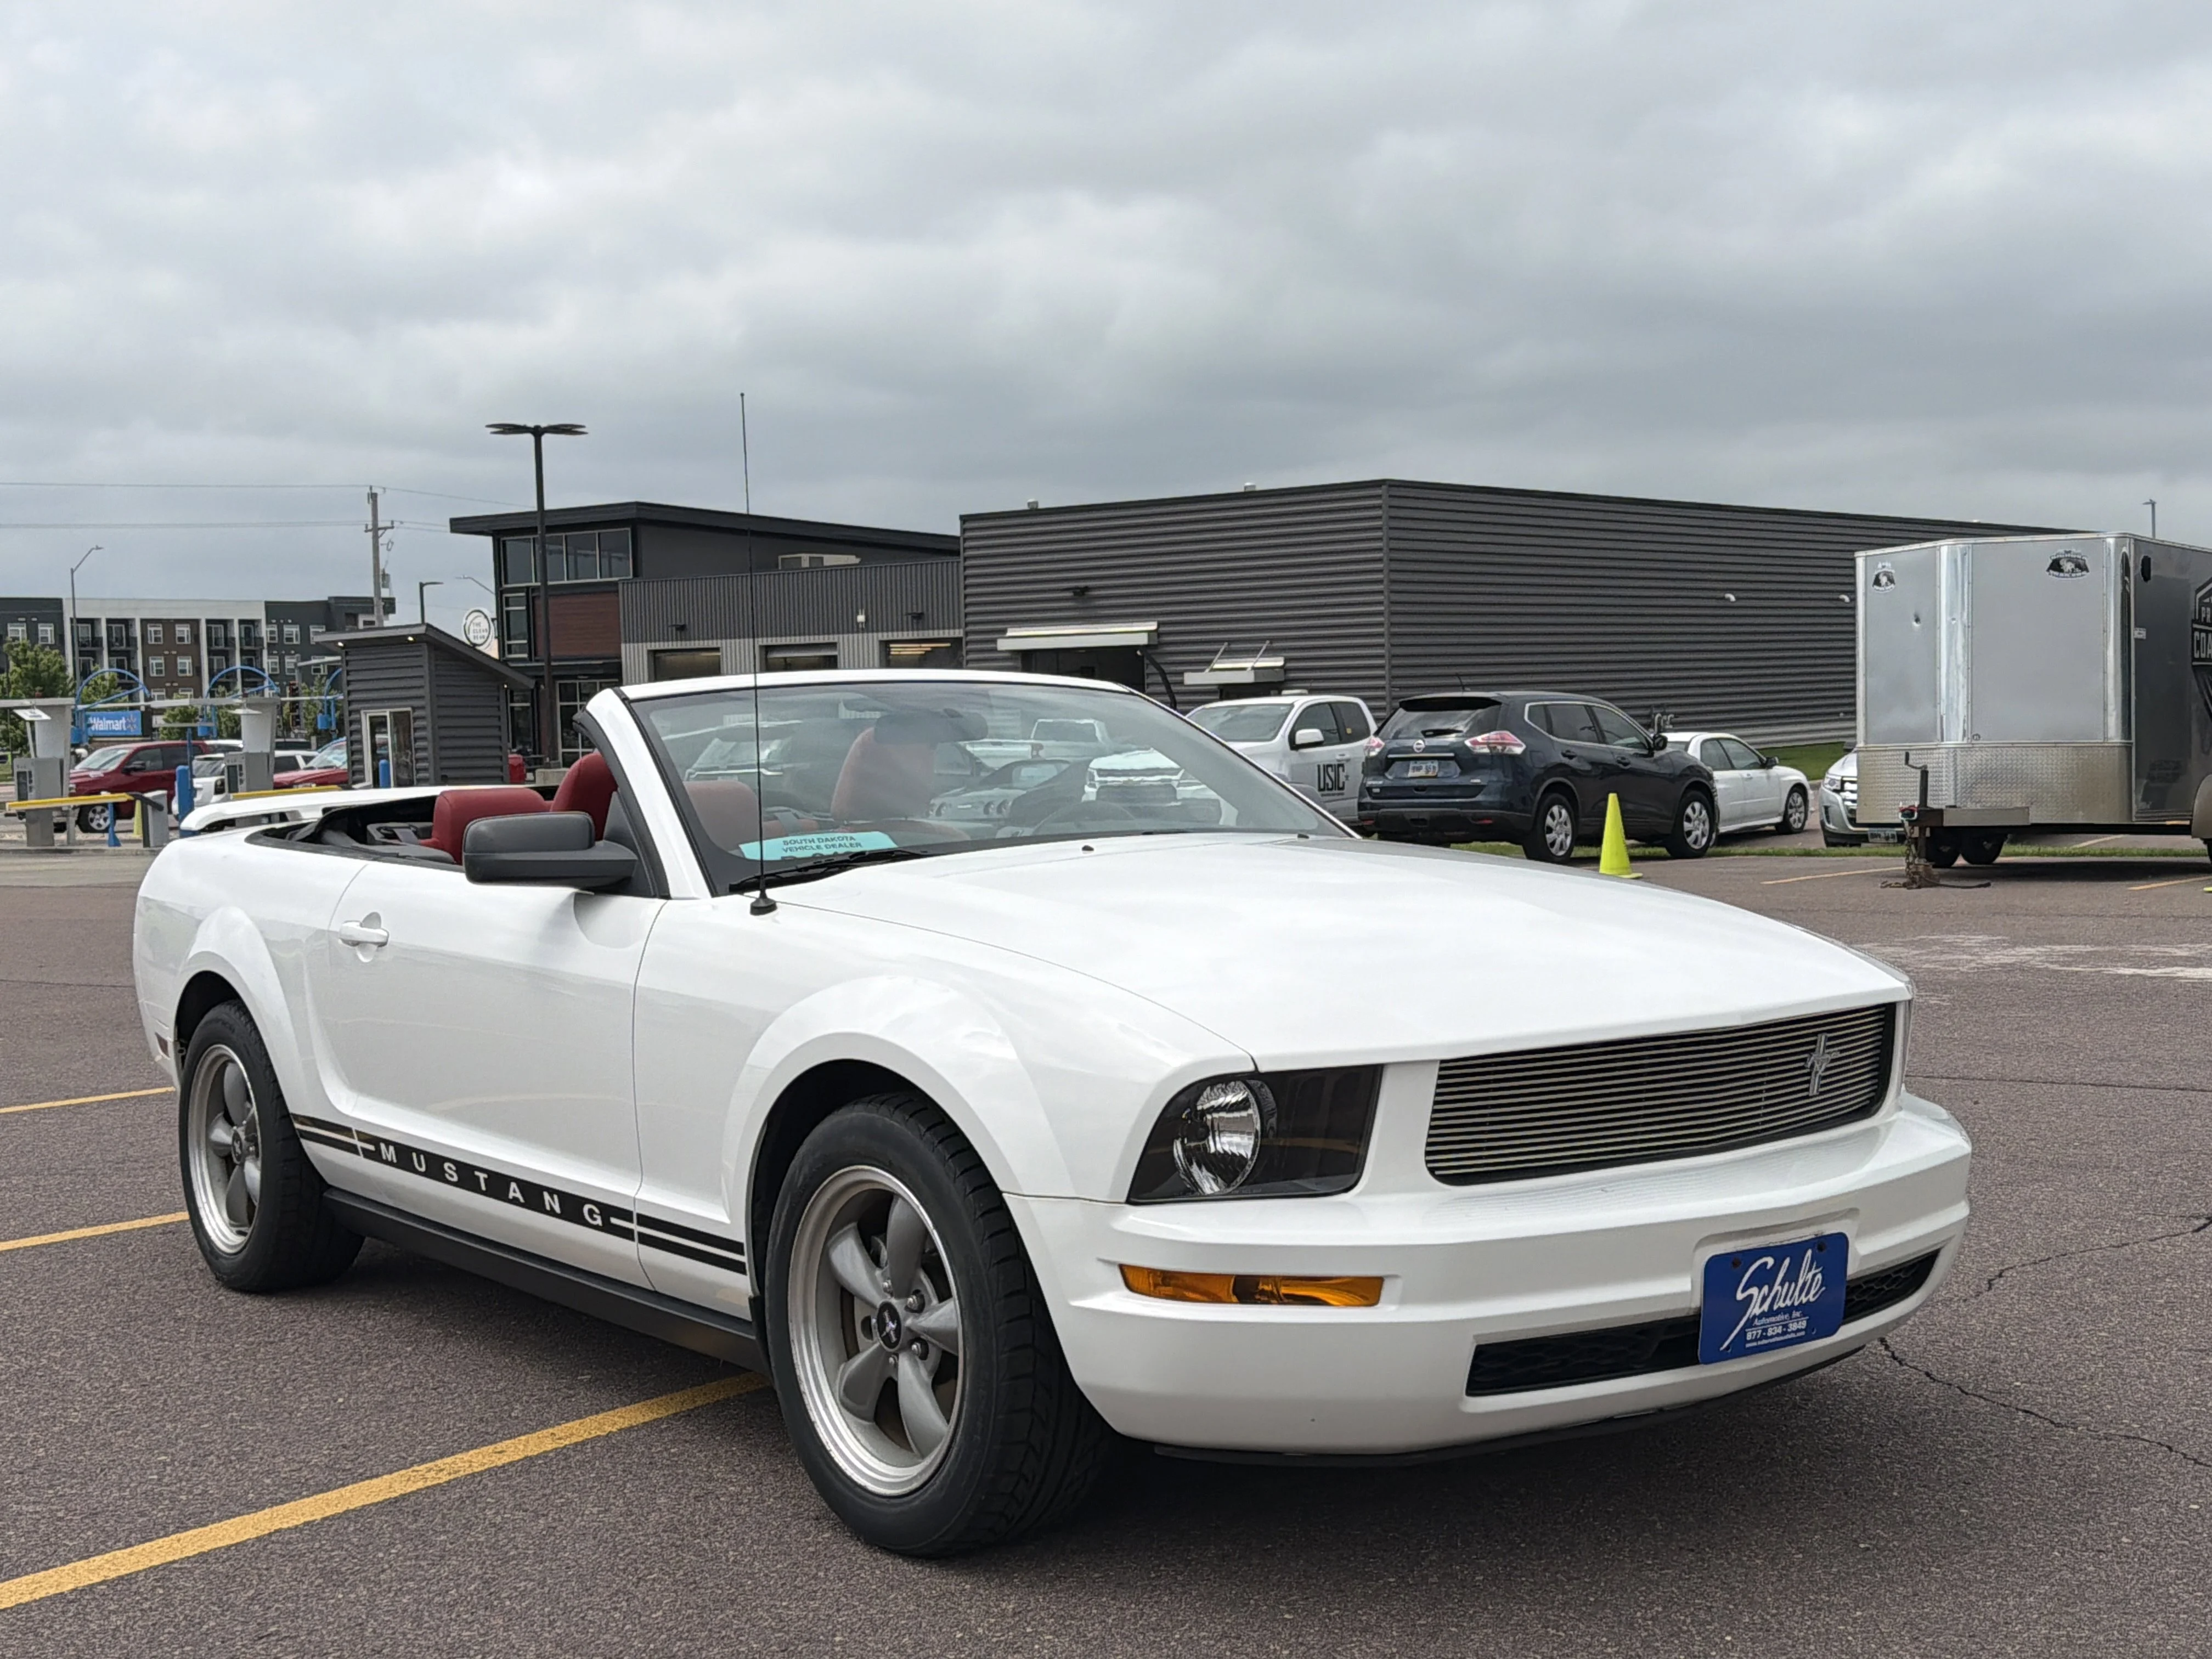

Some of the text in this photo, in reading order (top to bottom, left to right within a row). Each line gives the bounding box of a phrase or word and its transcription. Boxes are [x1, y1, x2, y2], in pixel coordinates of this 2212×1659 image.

[88, 716, 126, 731] Walmart
[1317, 763, 1345, 792] USIC
[782, 836, 856, 846] SOUTH DAKOTA
[782, 844, 822, 853] VEHICLE
[379, 1142, 603, 1227] MUSTANG
[1719, 1249, 1826, 1351] Schulte
